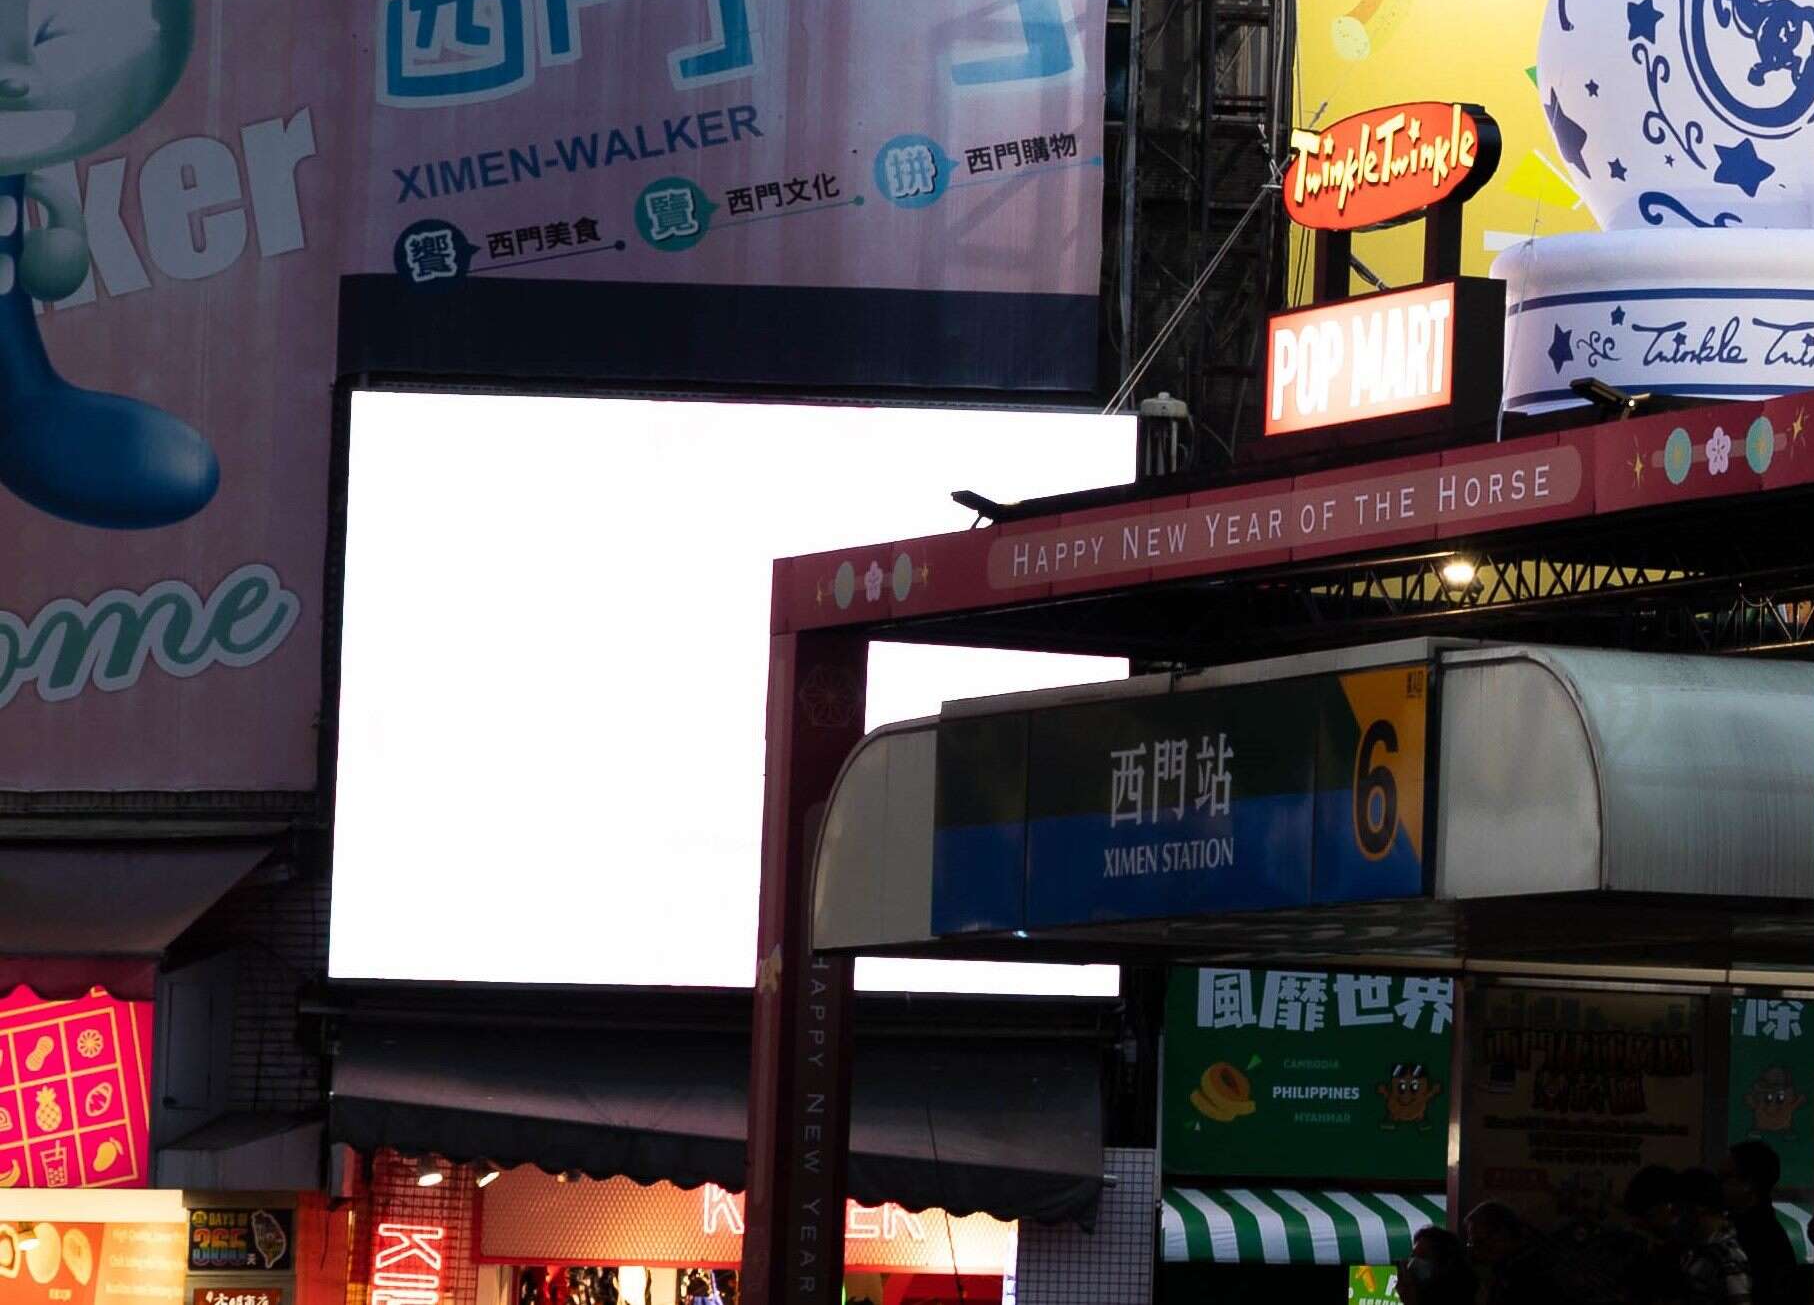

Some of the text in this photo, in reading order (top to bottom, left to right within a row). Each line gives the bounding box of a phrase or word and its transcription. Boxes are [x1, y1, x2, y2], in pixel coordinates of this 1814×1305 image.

[393, 103, 764, 205] XIMEN-WALKER
[726, 173, 840, 217] 西門文化
[964, 132, 1078, 176] 西門購物
[1290, 103, 1476, 212] Twinkle Twinkle
[485, 216, 602, 260] 西門美食
[1271, 298, 1451, 422] POP MART
[1631, 315, 1748, 365] Twinkle
[1012, 464, 1552, 577] HAPPY NEW YEAR OF THE HORSE
[1110, 732, 1235, 829] 西門站
[1354, 719, 1399, 858] 6
[1103, 837, 1235, 880] XIMEN STATION
[799, 956, 829, 1292] HAPPY NEW YEAR
[1272, 1085, 1360, 1100] PHILIPPINES
